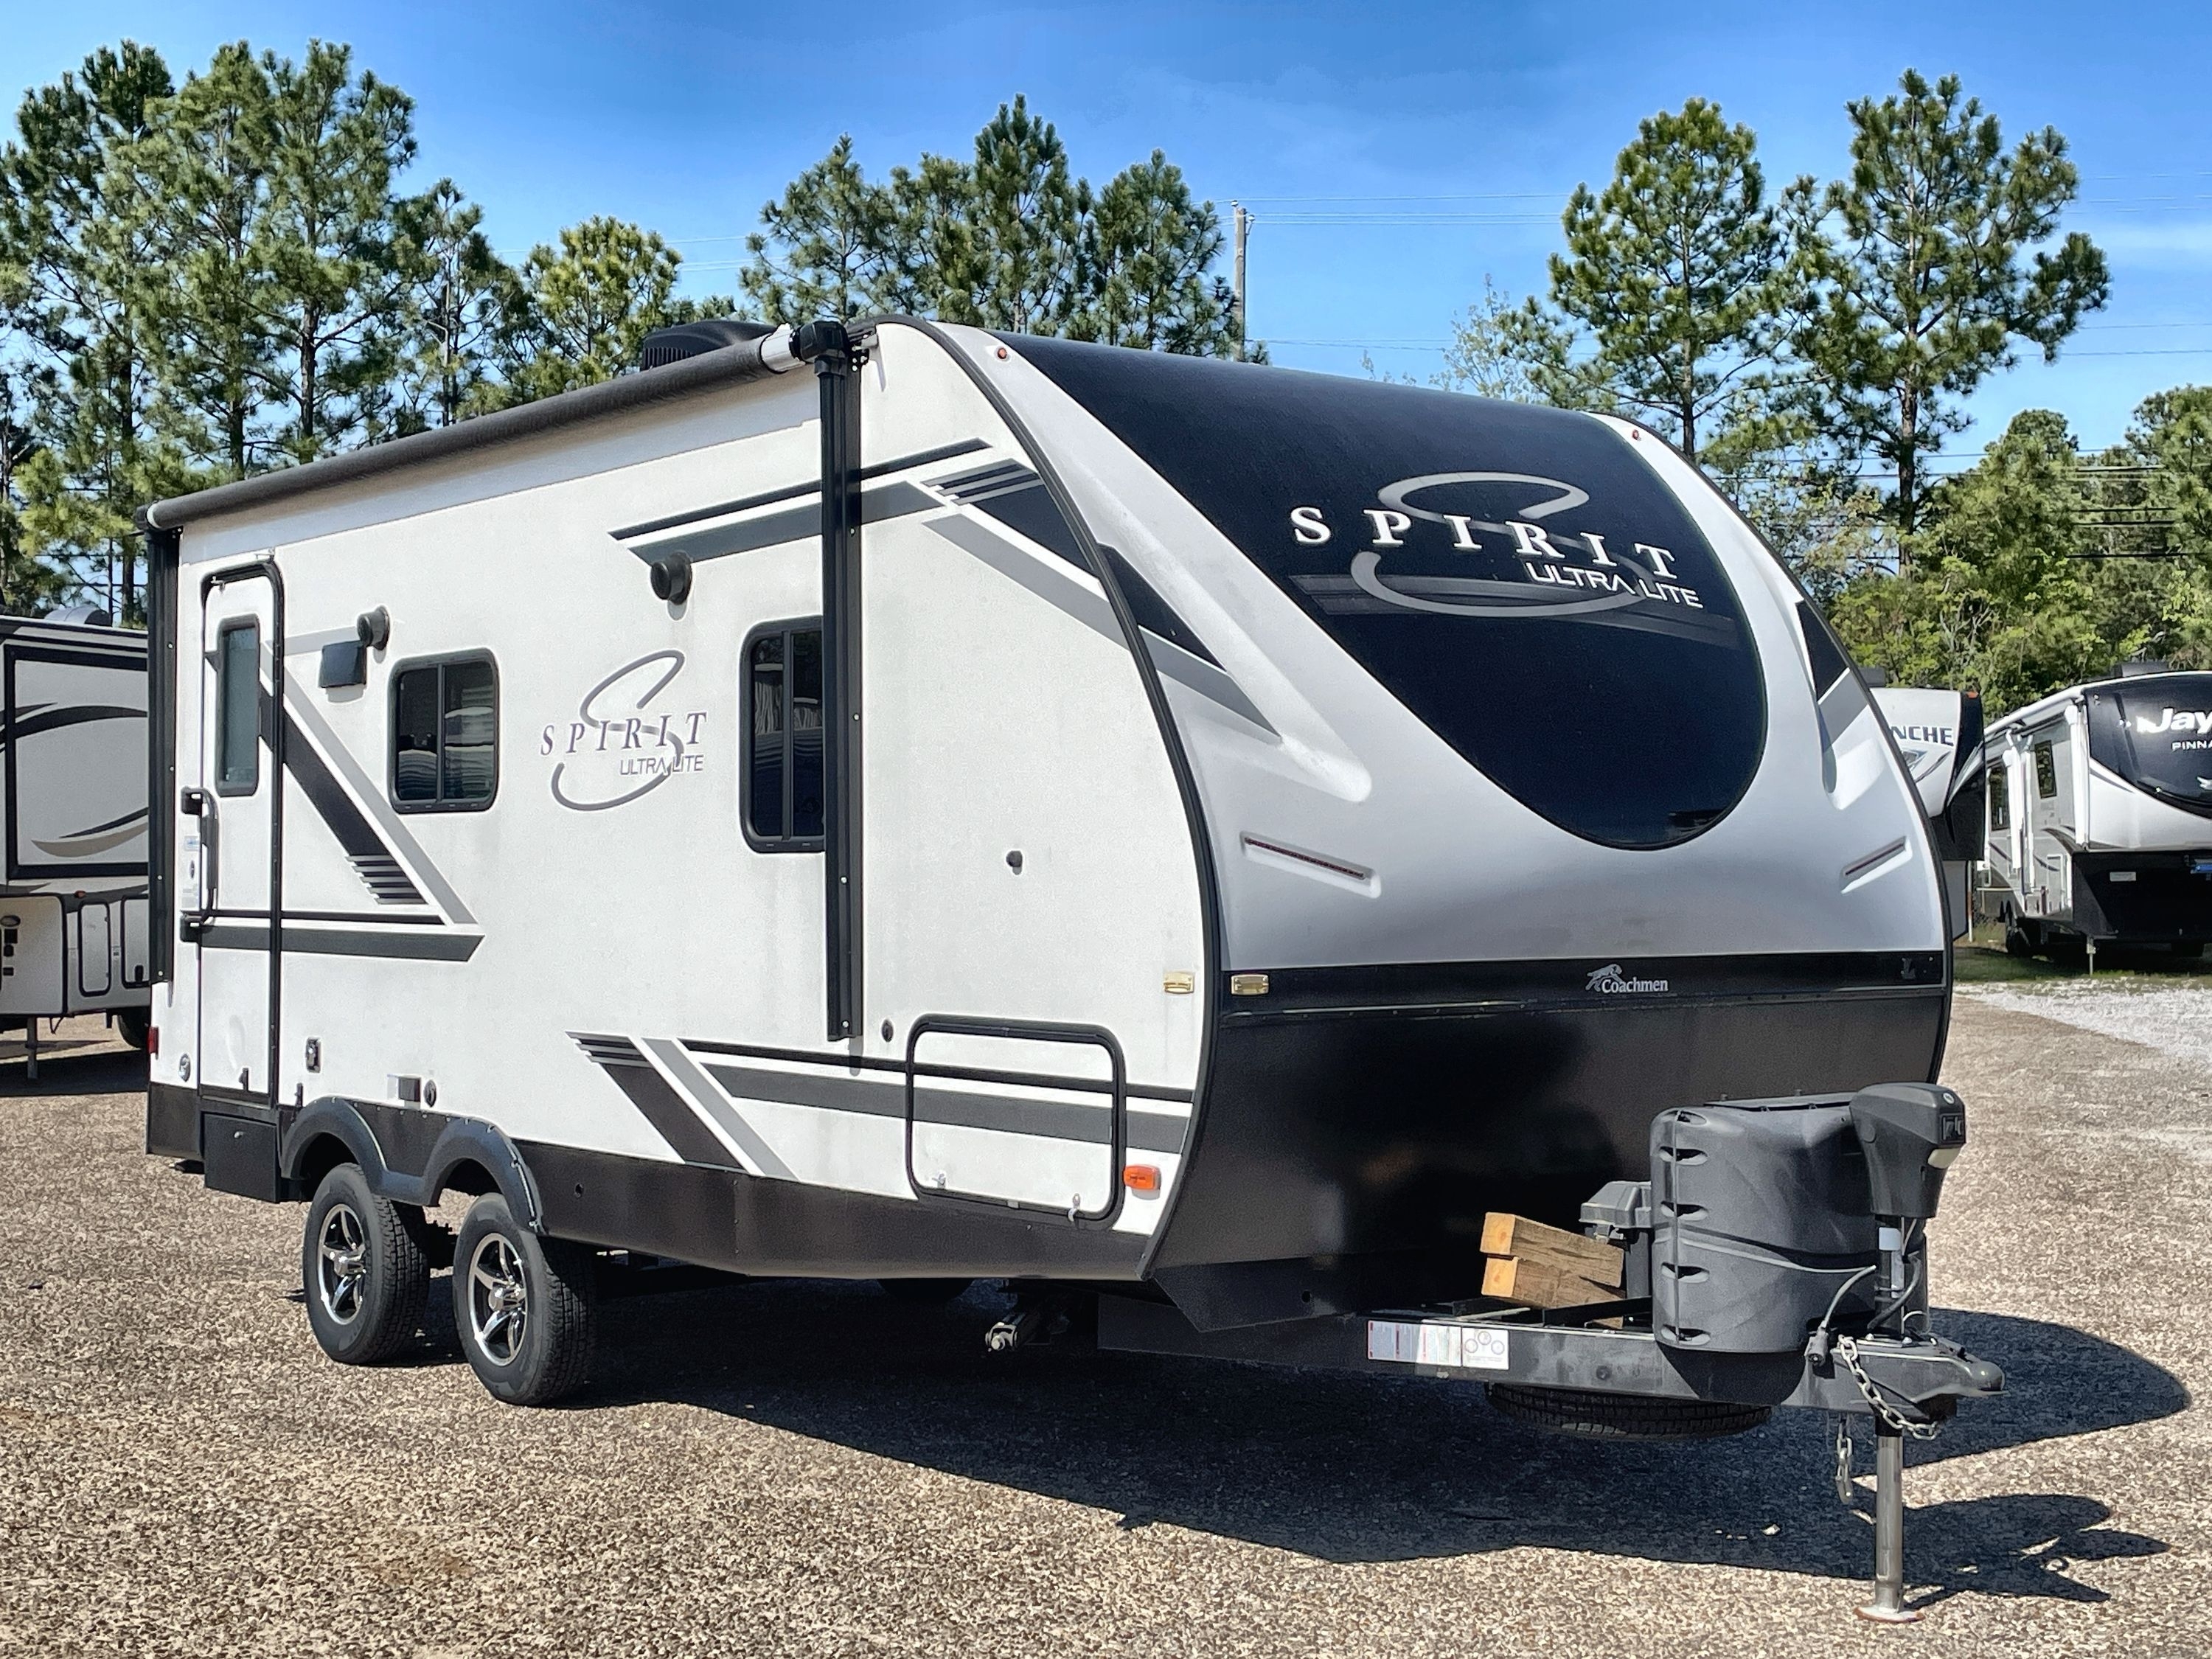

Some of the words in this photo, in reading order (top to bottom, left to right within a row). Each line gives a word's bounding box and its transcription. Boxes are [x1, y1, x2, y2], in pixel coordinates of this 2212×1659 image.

[1290, 507, 1678, 579] SPIRIT
[1525, 562, 1635, 595] ULTRA
[1640, 579, 1703, 609] LITE
[540, 712, 707, 756] SPIRIT
[620, 757, 667, 775] ULTRA
[672, 754, 704, 772] LITE
[1601, 977, 1669, 994] Coachmen
